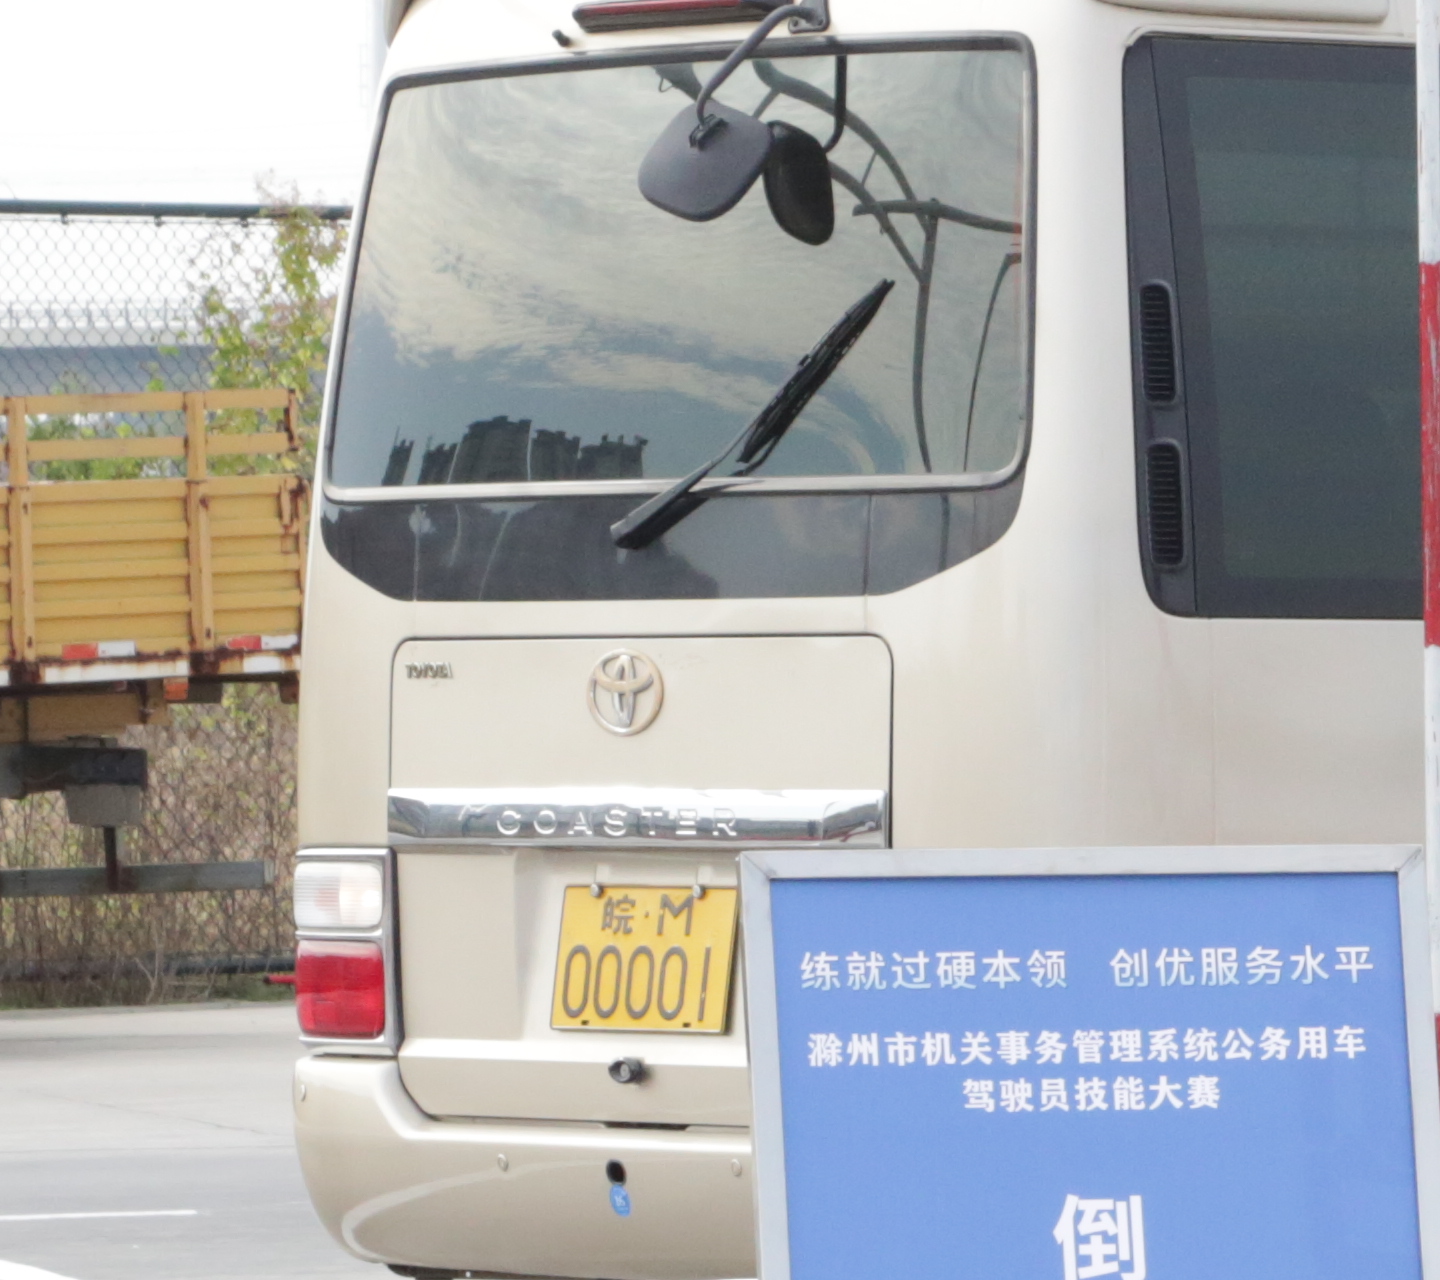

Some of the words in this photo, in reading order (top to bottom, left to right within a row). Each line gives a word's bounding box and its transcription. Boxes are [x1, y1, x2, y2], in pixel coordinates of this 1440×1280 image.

[496, 806, 737, 836] COASTER
[562, 944, 711, 1022] 00001
[800, 949, 1068, 991] 练就过硬本领
[1109, 944, 1374, 988] 创优服务水平
[807, 1025, 1367, 1067] 滁州市机关事务管理系统公务用车
[962, 1075, 1221, 1113] 驾驶员技能大赛
